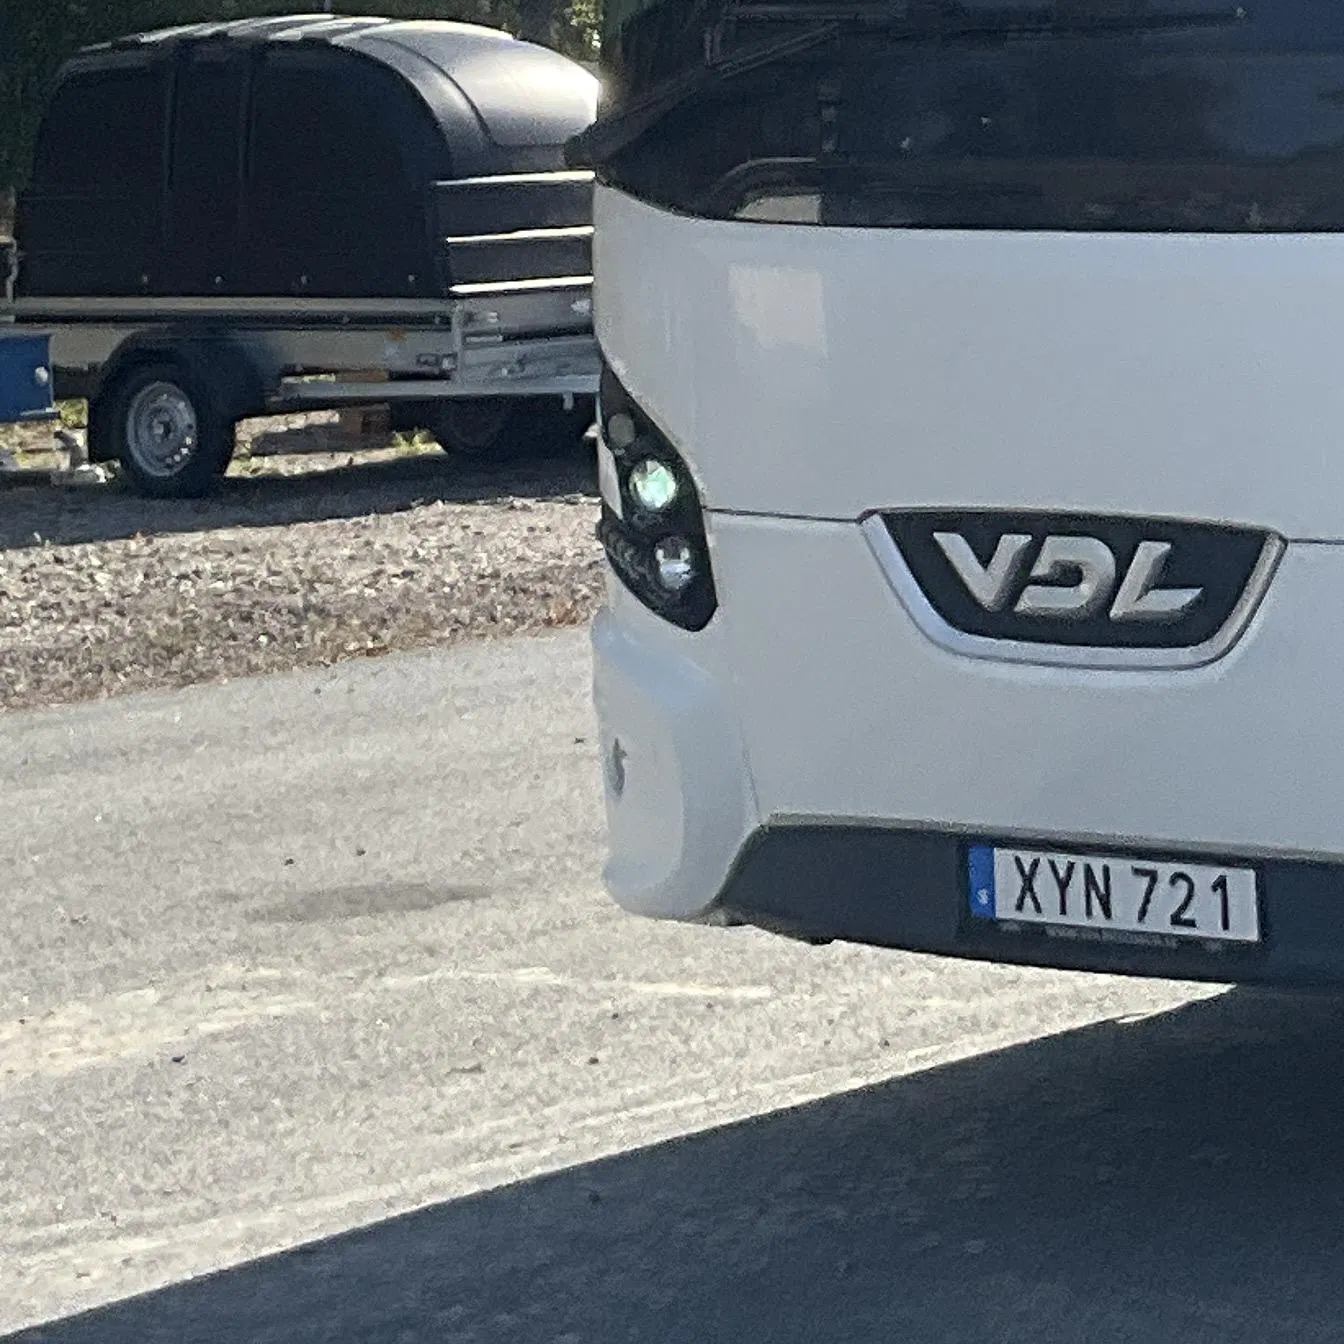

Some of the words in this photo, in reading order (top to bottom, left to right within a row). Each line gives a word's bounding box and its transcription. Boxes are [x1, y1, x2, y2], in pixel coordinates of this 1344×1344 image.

[933, 531, 1204, 620] VDL
[1013, 855, 1112, 920] XYN
[1131, 865, 1230, 931] 721
